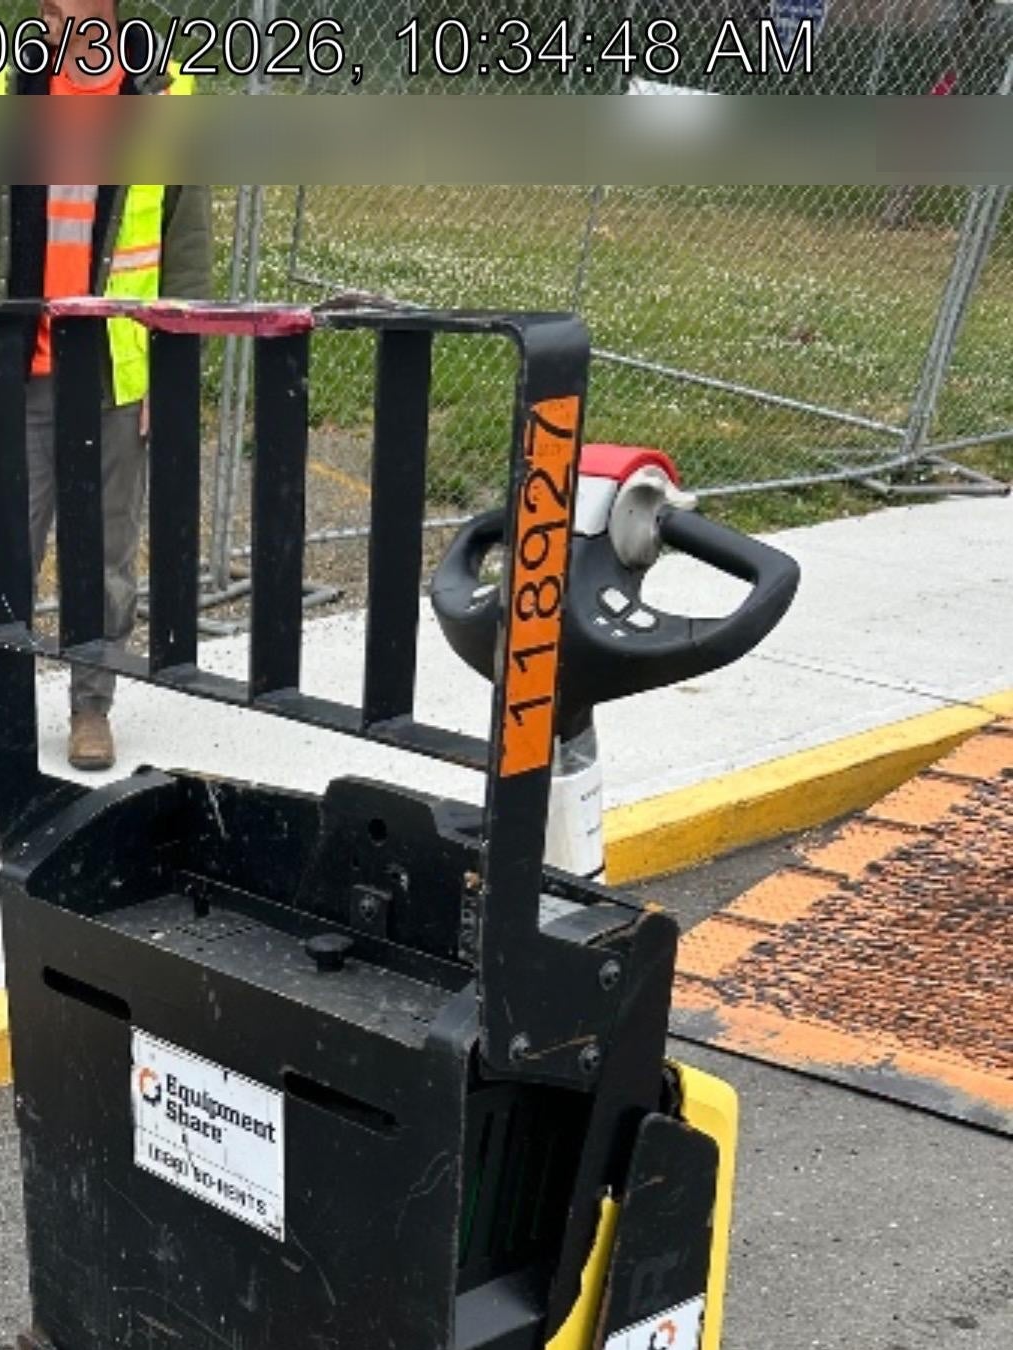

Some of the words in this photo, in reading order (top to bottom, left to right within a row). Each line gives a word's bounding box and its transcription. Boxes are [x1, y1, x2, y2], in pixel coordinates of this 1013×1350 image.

[509, 408, 574, 729] 118927
[165, 1073, 277, 1144] Equipment
[165, 1100, 223, 1144] Share
